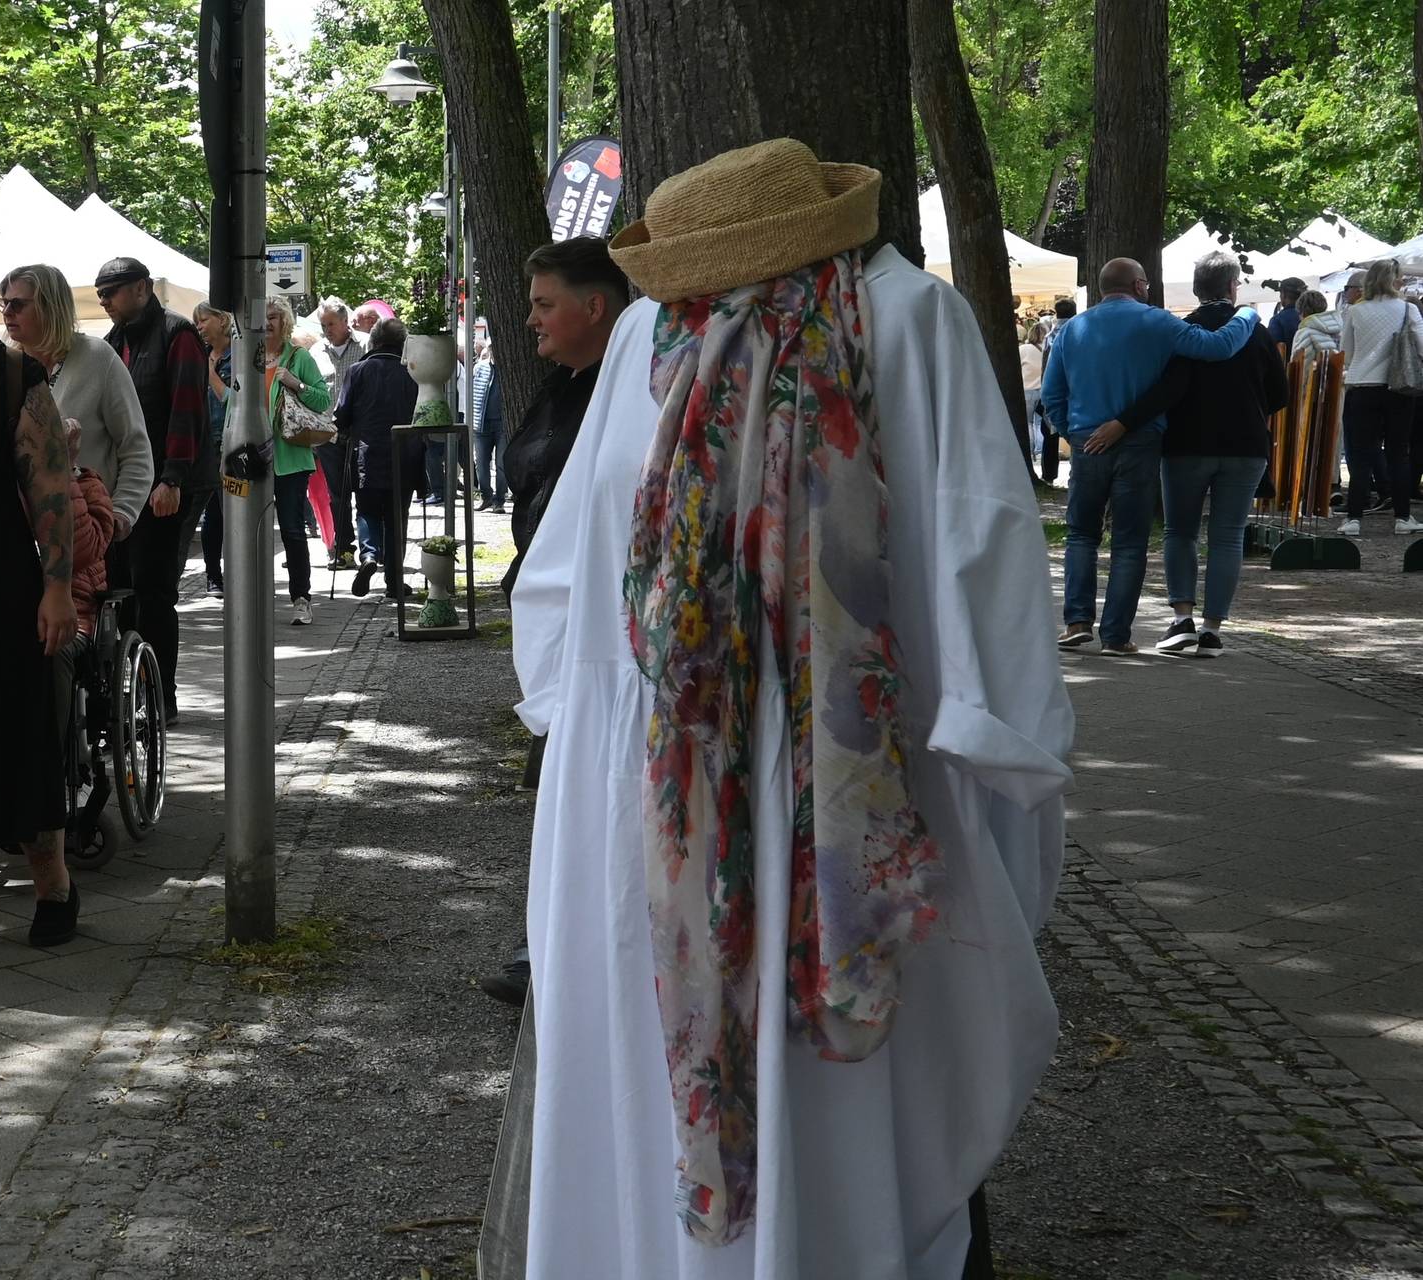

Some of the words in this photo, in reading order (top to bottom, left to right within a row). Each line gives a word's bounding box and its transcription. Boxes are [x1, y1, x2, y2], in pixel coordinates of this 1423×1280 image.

[552, 186, 580, 242] UNST
[571, 173, 599, 240] ERKERINNEN
[586, 190, 612, 237] RKT
[223, 478, 244, 497] HEN
